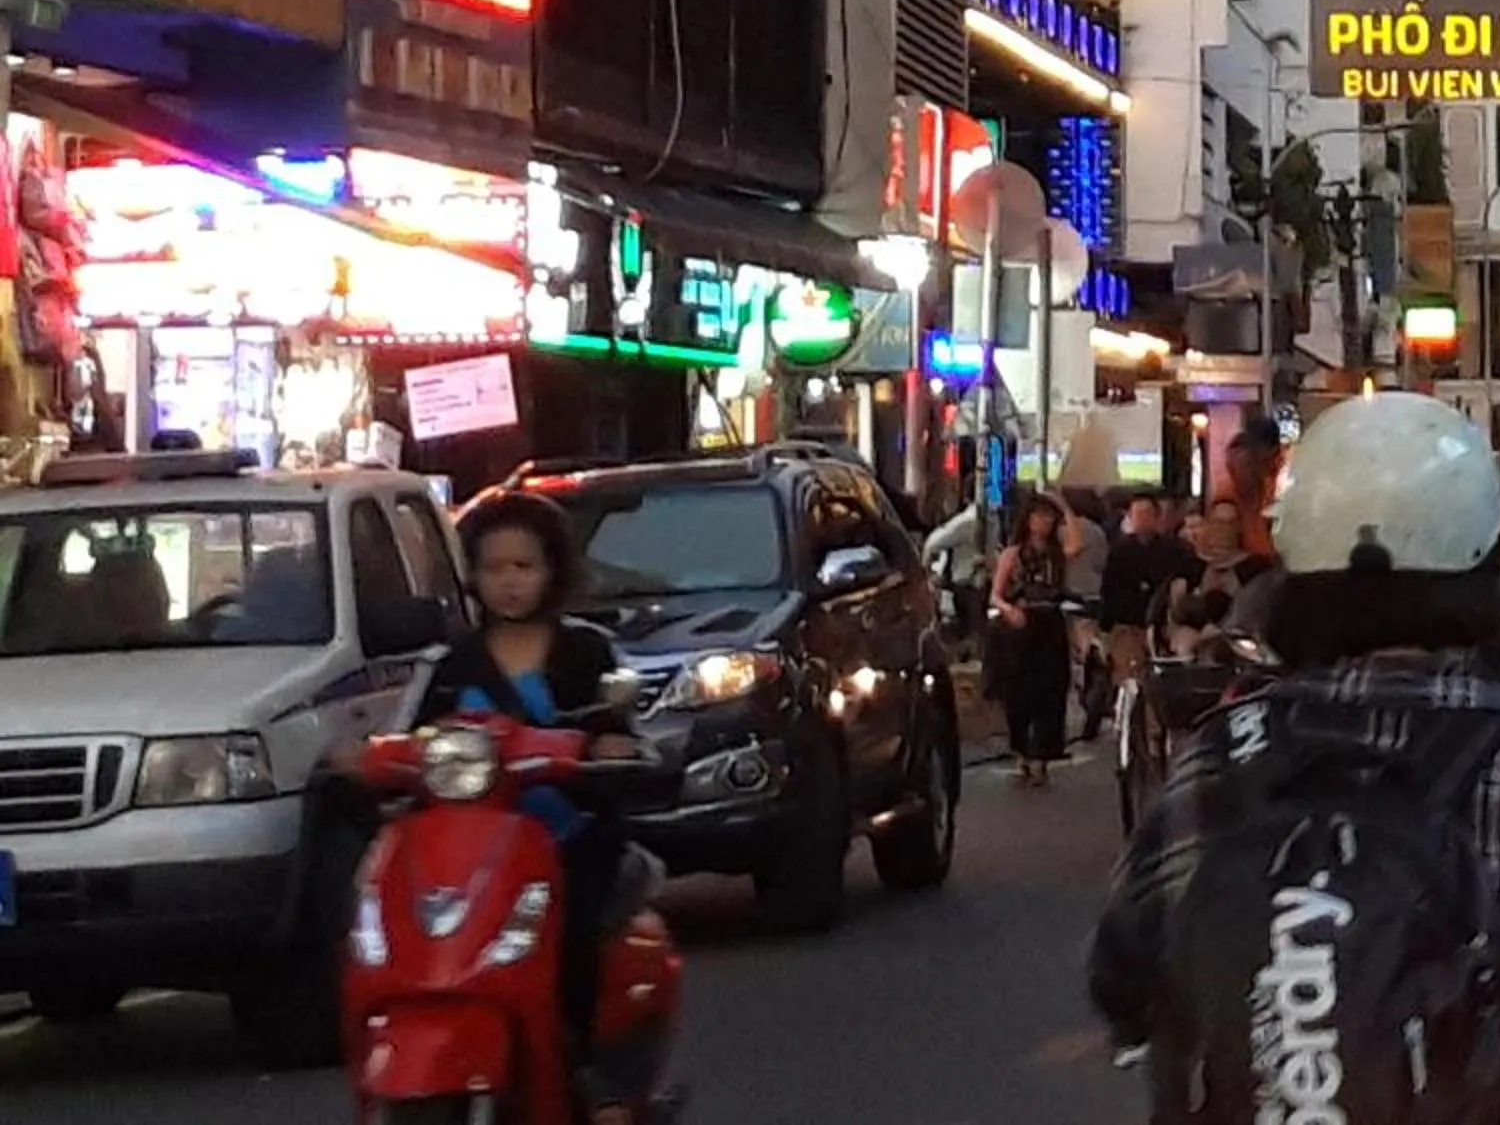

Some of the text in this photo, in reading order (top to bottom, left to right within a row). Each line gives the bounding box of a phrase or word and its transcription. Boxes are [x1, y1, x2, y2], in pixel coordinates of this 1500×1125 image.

[1441, 14, 1492, 57] ĐI
[1343, 69, 1398, 99] BUI
[1407, 69, 1484, 99] VIEN
